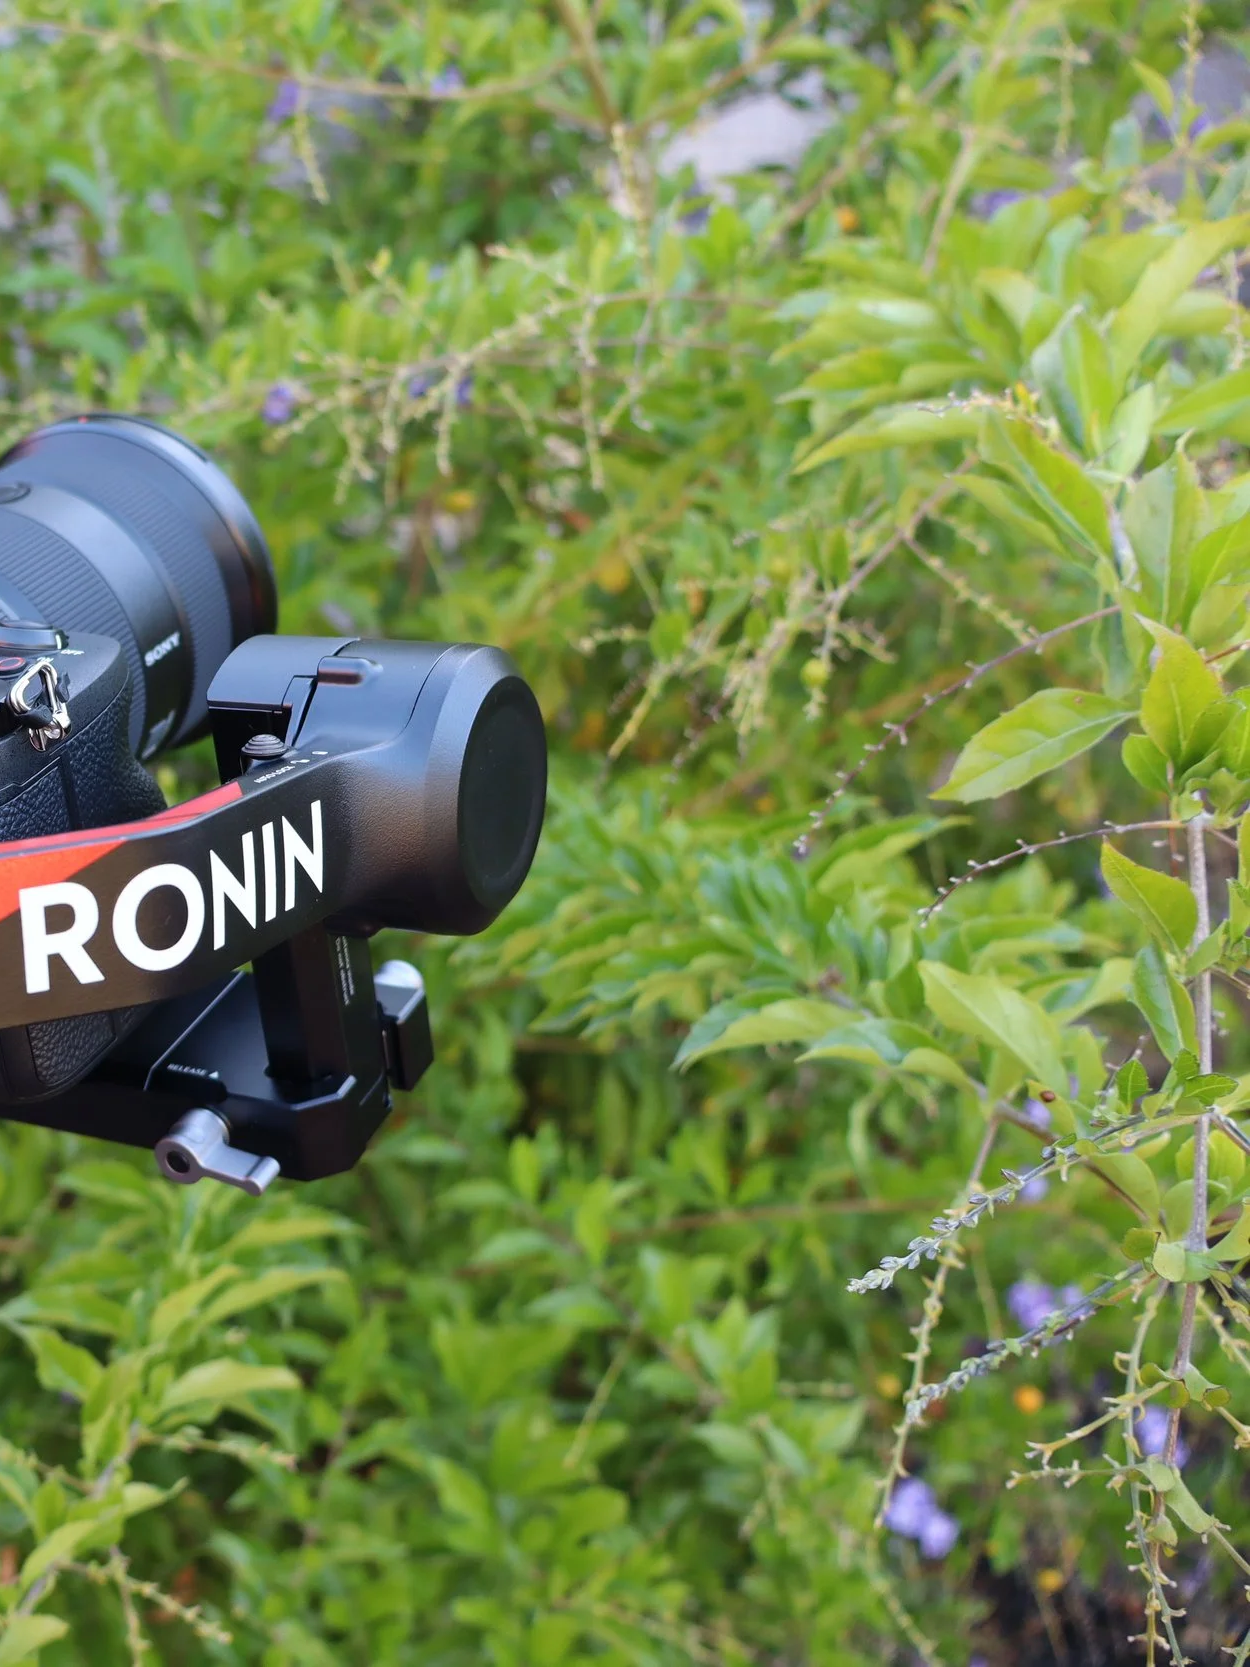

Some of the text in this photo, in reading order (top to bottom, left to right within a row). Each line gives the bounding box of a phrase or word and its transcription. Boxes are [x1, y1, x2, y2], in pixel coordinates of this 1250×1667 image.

[60, 648, 85, 656] OFF
[145, 630, 180, 668] SONY
[18, 799, 323, 994] RONIN
[167, 1063, 208, 1077] RELEASE
